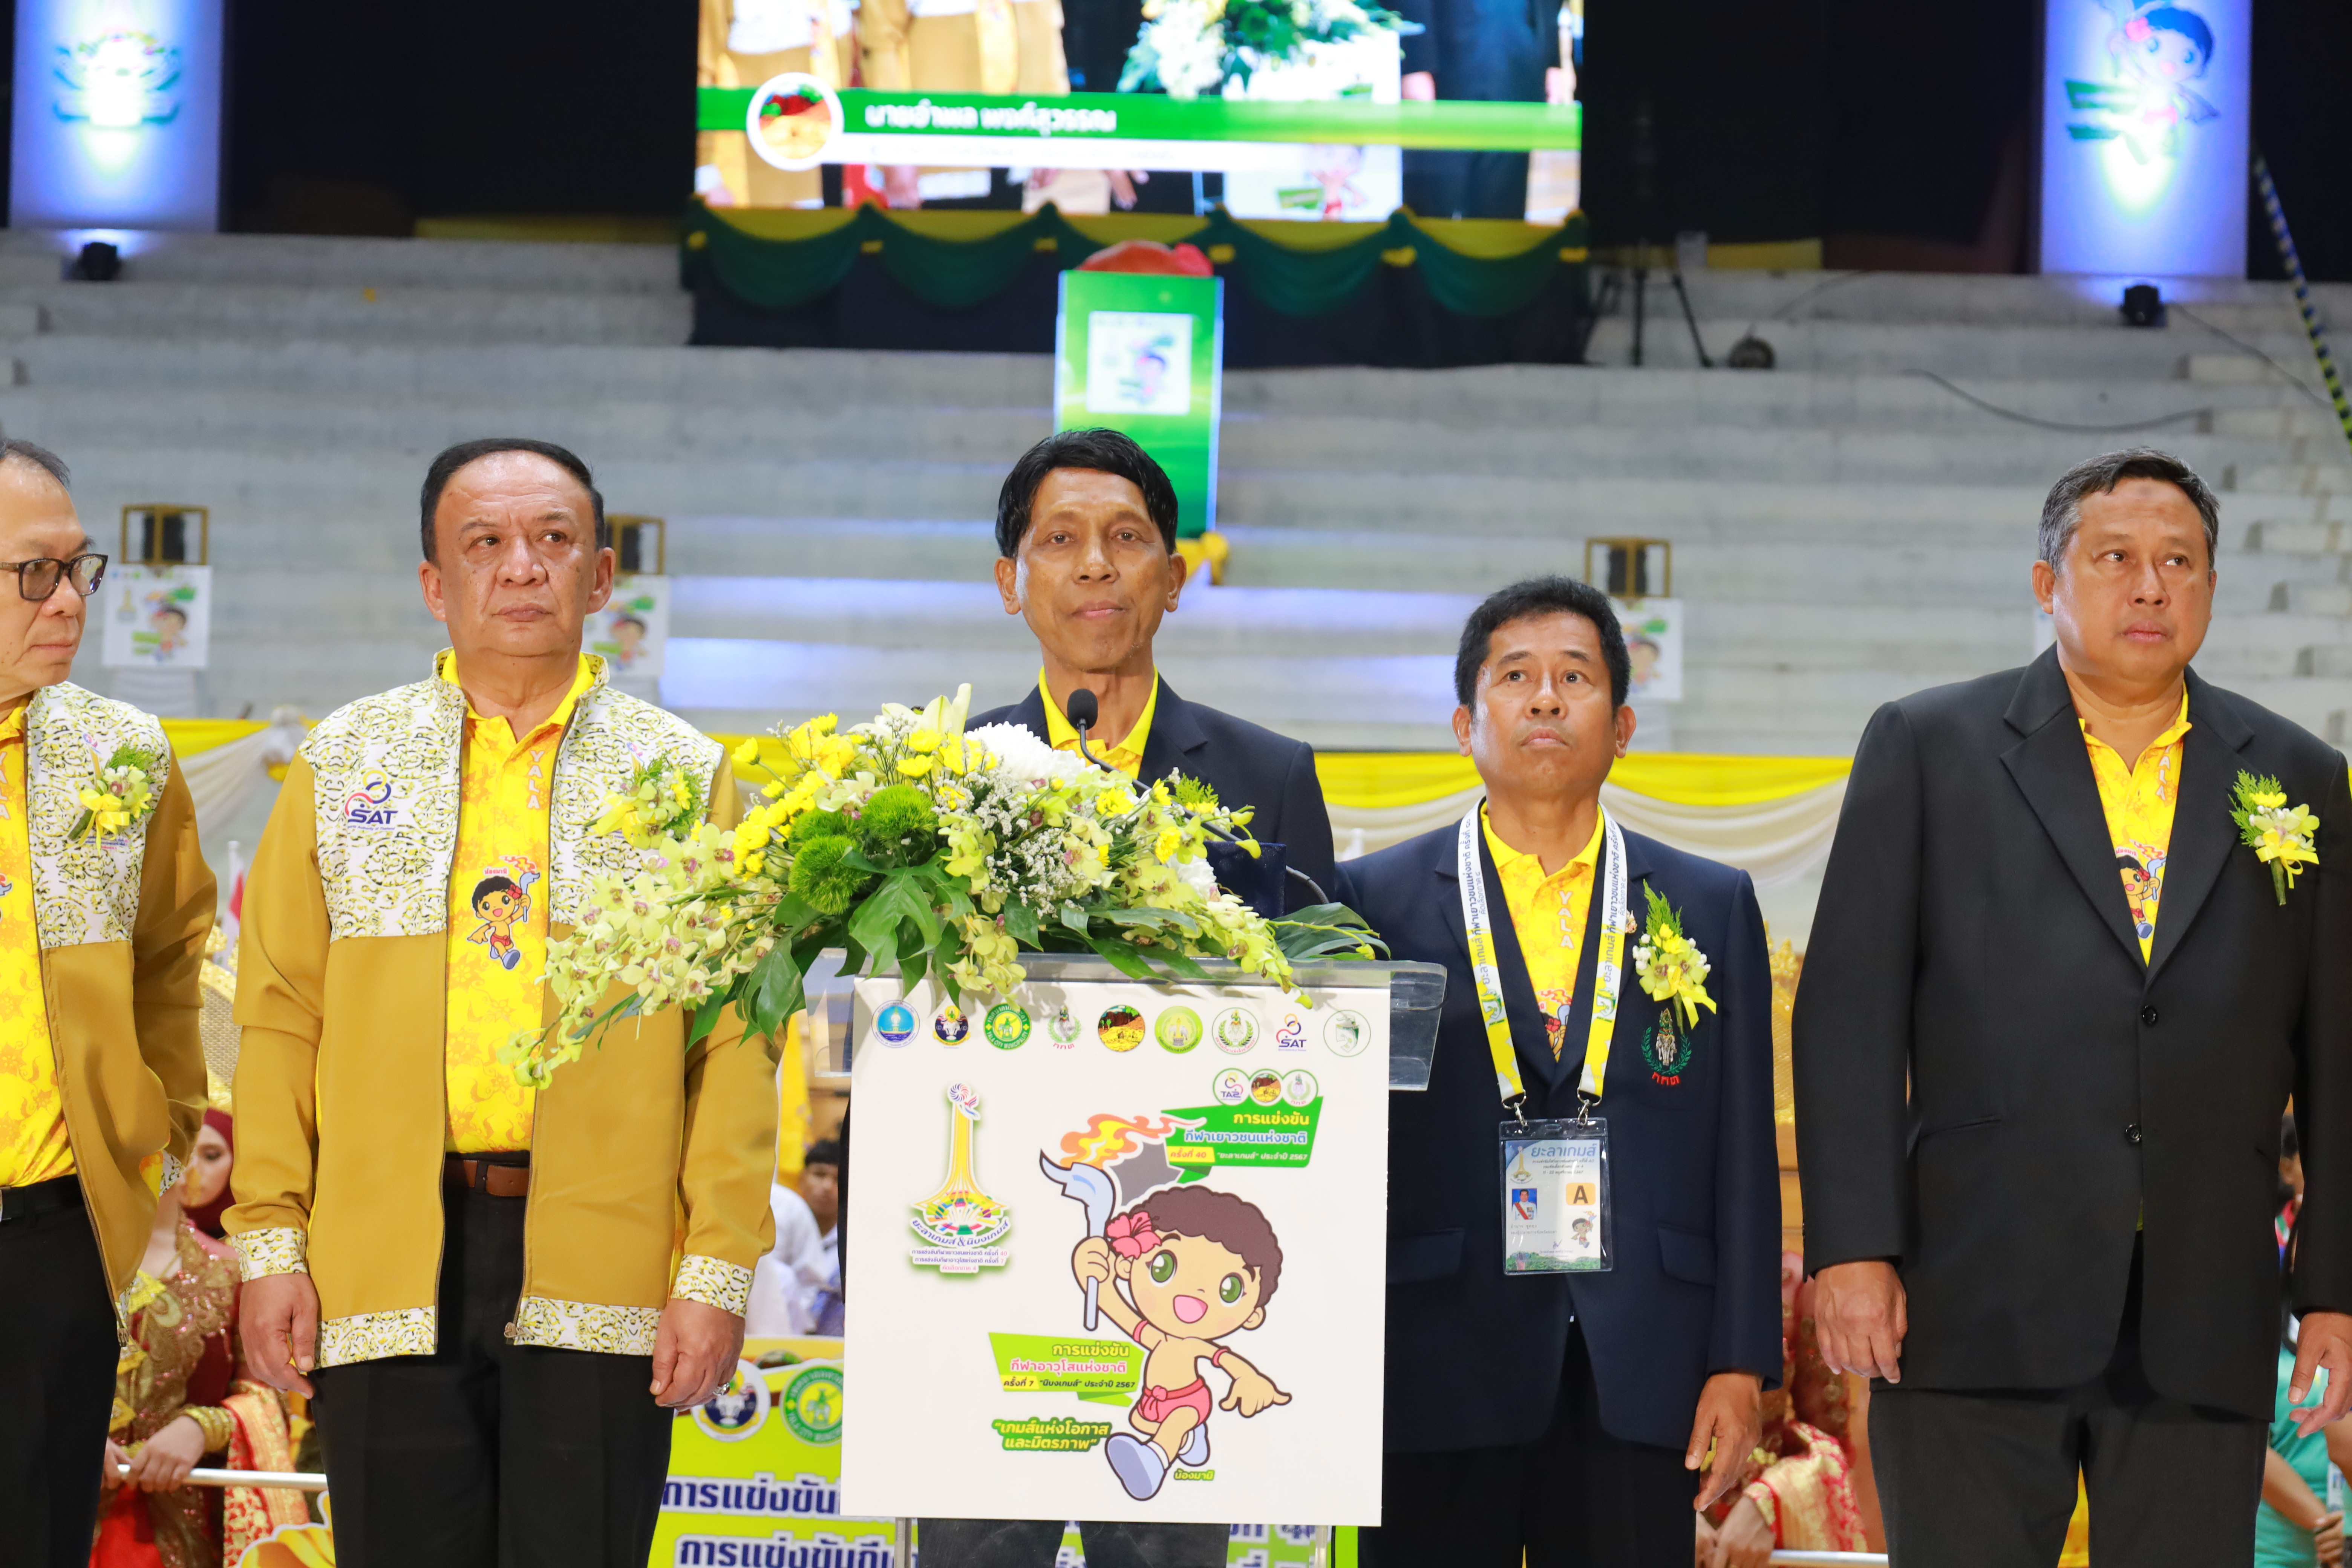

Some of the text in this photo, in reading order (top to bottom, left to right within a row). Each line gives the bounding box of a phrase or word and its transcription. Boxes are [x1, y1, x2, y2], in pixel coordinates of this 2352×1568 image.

[527, 750, 544, 809] YALA
[348, 809, 398, 824] SAT
[1557, 890, 1574, 949] YALA
[987, 1031, 995, 1043] YALA
[1279, 1039, 1307, 1048] SAT
[1234, 1110, 1309, 1125] การแข่งขัน
[1185, 1130, 1307, 1144] กีฬาเยาวชนแห่งชาติ
[1170, 1148, 1192, 1158] ครั้งที่
[1261, 1152, 1288, 1160] ประจำปี
[1531, 1143, 1597, 1157] ยะลาเกมส์
[1573, 1185, 1588, 1204] A
[957, 1236, 966, 1246] &
[1053, 1341, 1129, 1357] การแข่งขัน
[1011, 1359, 1126, 1375] กีฬาอาวุโสแห่งชาติ
[1004, 1377, 1026, 1387] ครั้งที่
[1174, 1469, 1214, 1479] น้องมานิ
